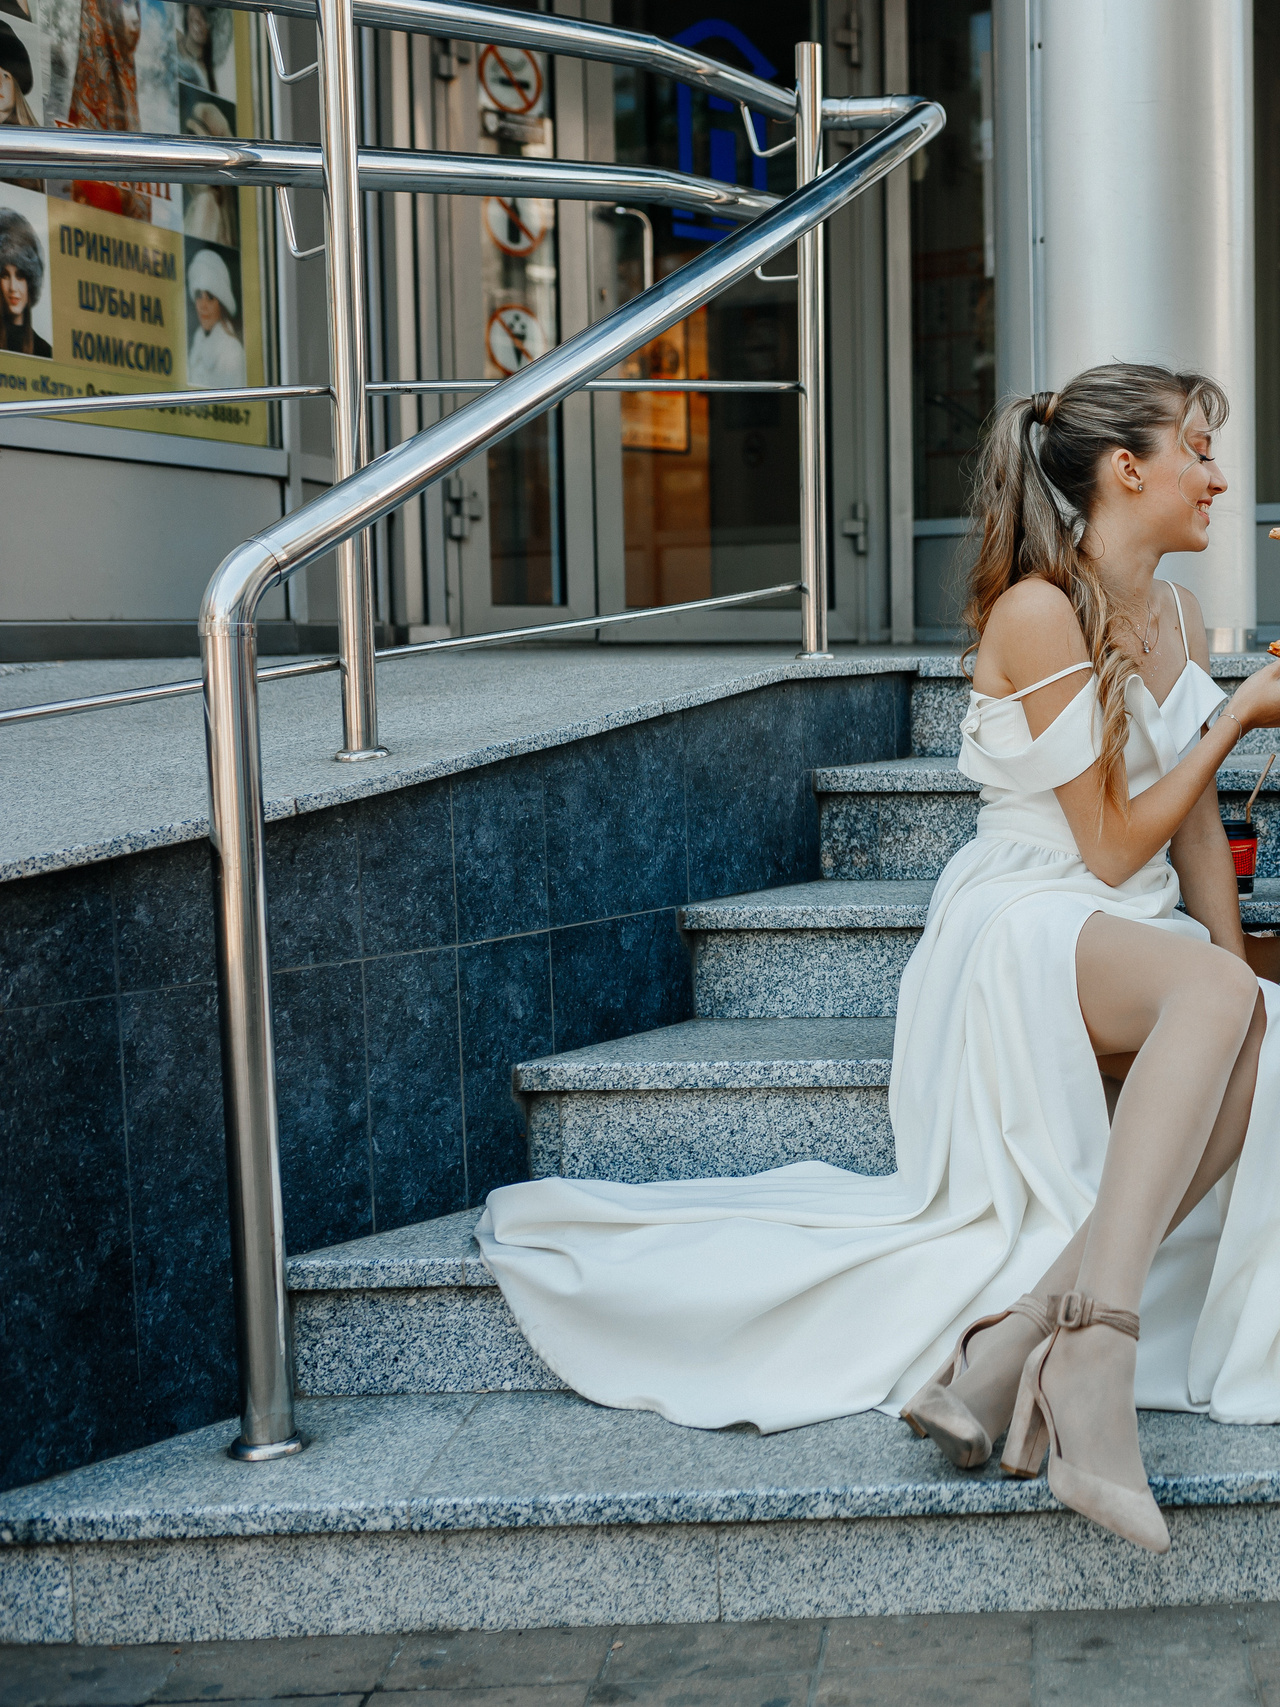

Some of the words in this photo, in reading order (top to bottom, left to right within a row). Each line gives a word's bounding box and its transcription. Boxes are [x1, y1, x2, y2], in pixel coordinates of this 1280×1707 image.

[60, 224, 177, 281] ПРИНИМАЕМ
[77, 279, 136, 321] ШУБЫ
[139, 293, 165, 328] НА
[71, 329, 173, 377] КОМИССИЮ
